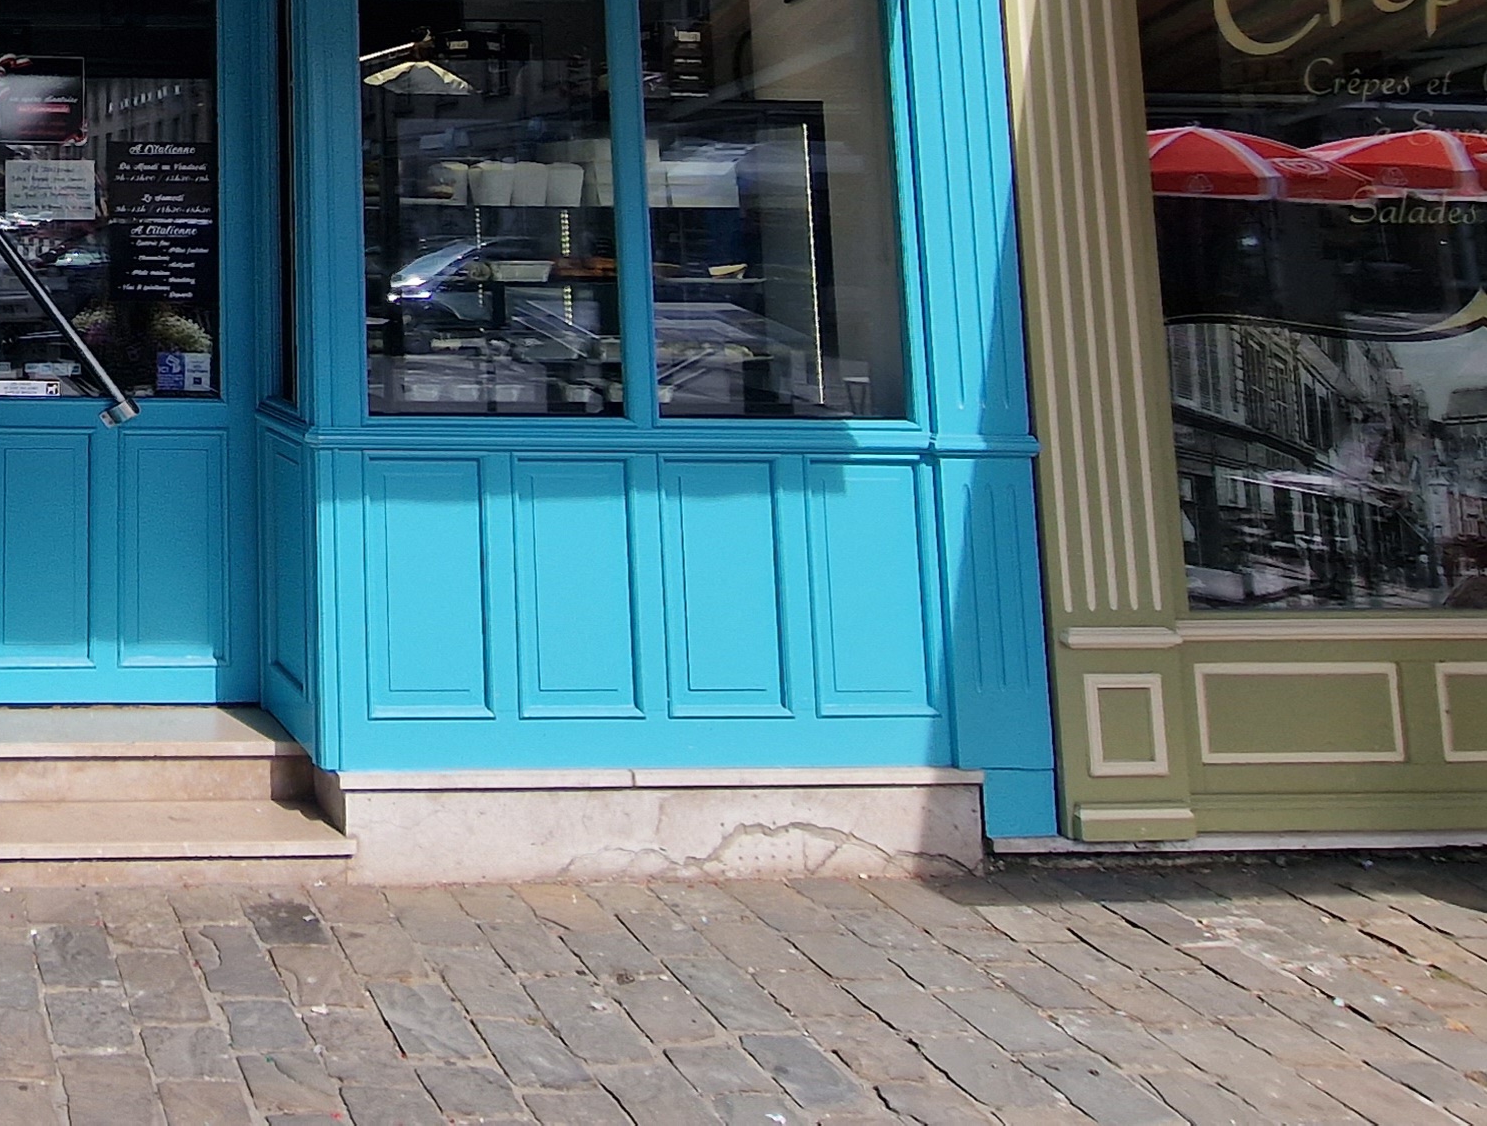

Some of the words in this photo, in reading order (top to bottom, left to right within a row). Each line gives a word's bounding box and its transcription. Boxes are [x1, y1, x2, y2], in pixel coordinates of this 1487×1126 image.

[1303, 56, 1411, 105] Crêpes
[1426, 70, 1452, 96] et
[1348, 185, 1478, 224] Salades
